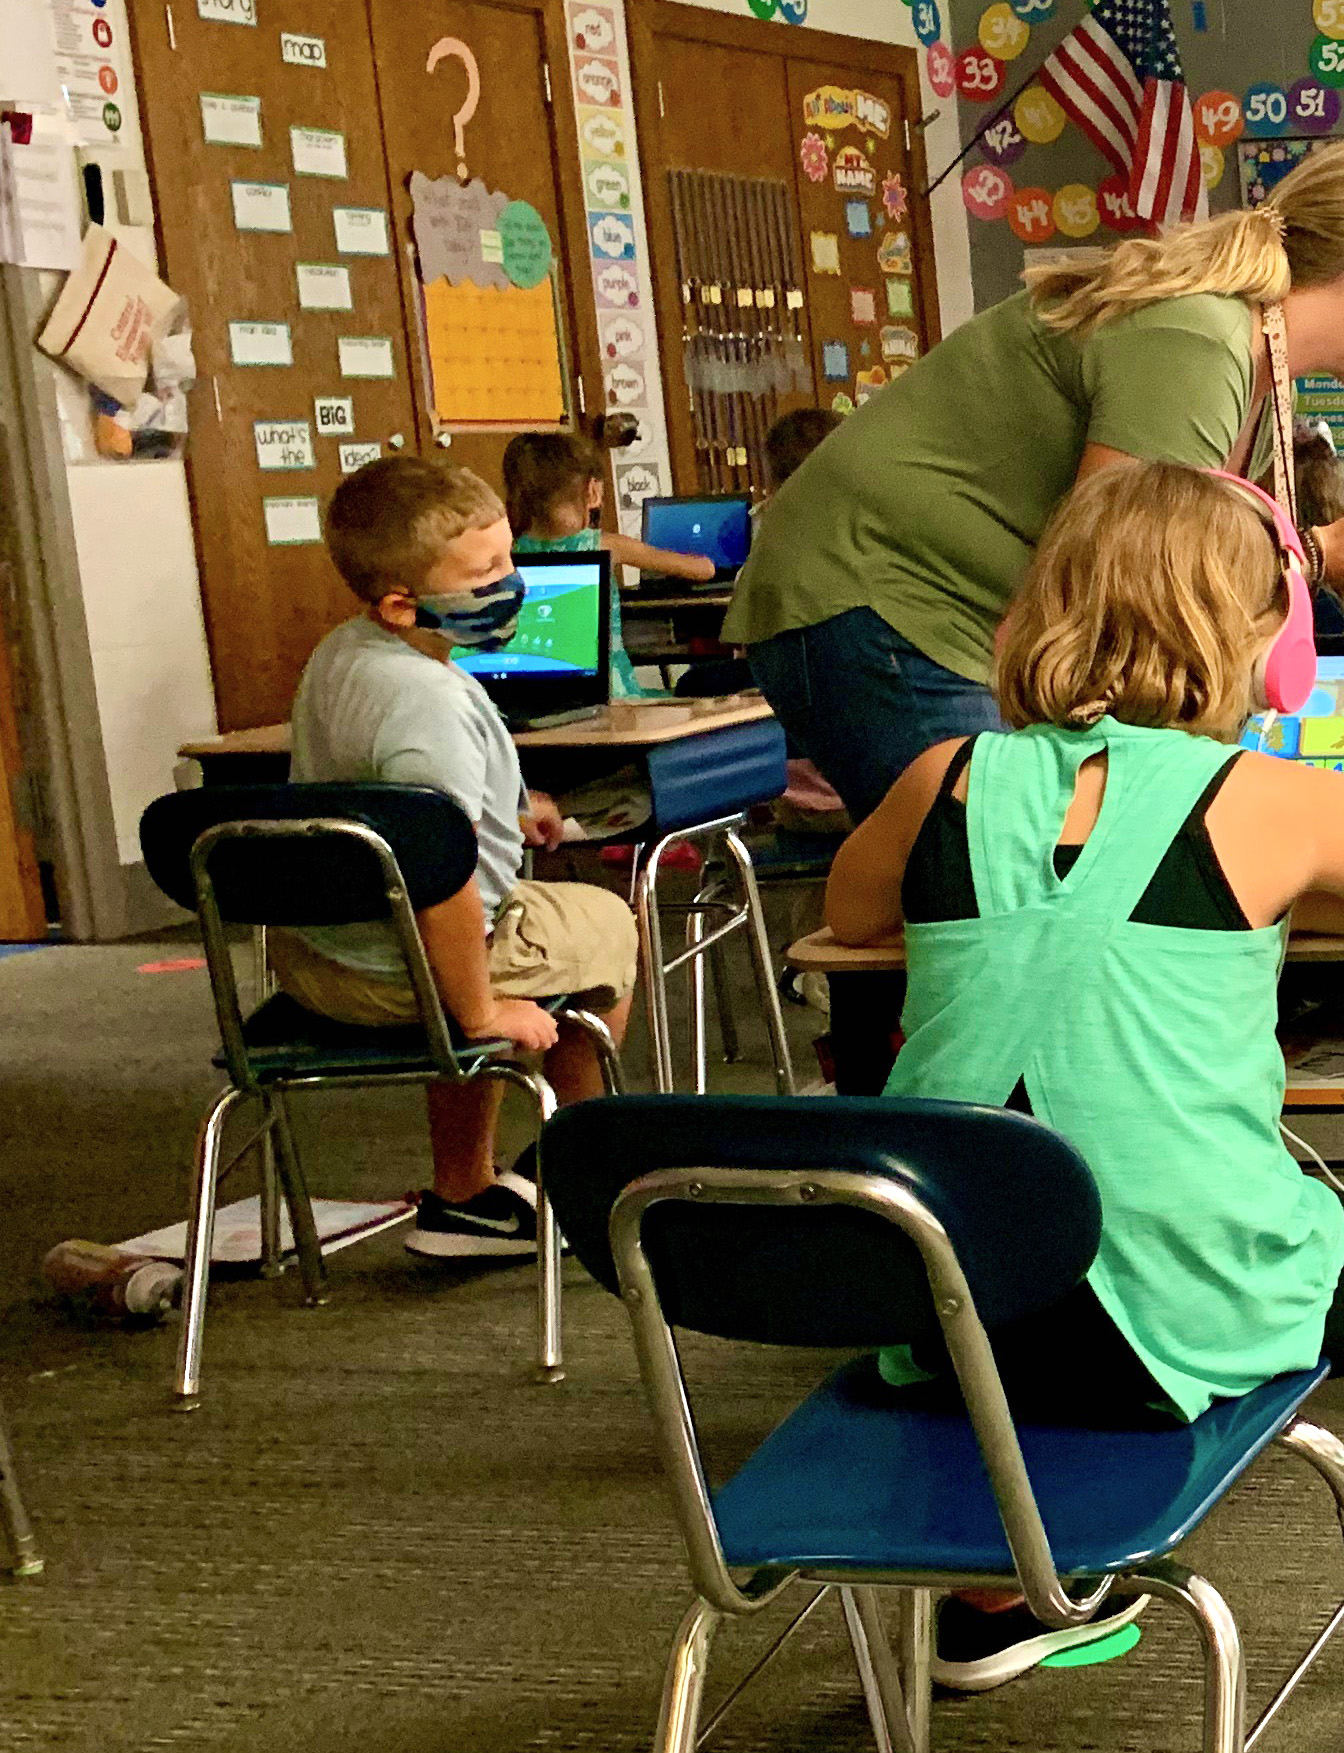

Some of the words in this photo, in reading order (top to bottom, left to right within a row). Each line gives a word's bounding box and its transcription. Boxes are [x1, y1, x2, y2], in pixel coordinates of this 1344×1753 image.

[918, 3, 935, 35] 31
[284, 39, 322, 61] map
[962, 56, 998, 90] 33
[1246, 92, 1287, 124] 50
[1296, 88, 1325, 117] 51
[1202, 103, 1240, 135] 49
[984, 120, 1022, 155] 42
[1016, 199, 1049, 232] 44
[280, 448, 305, 464] the
[628, 473, 652, 491] black
